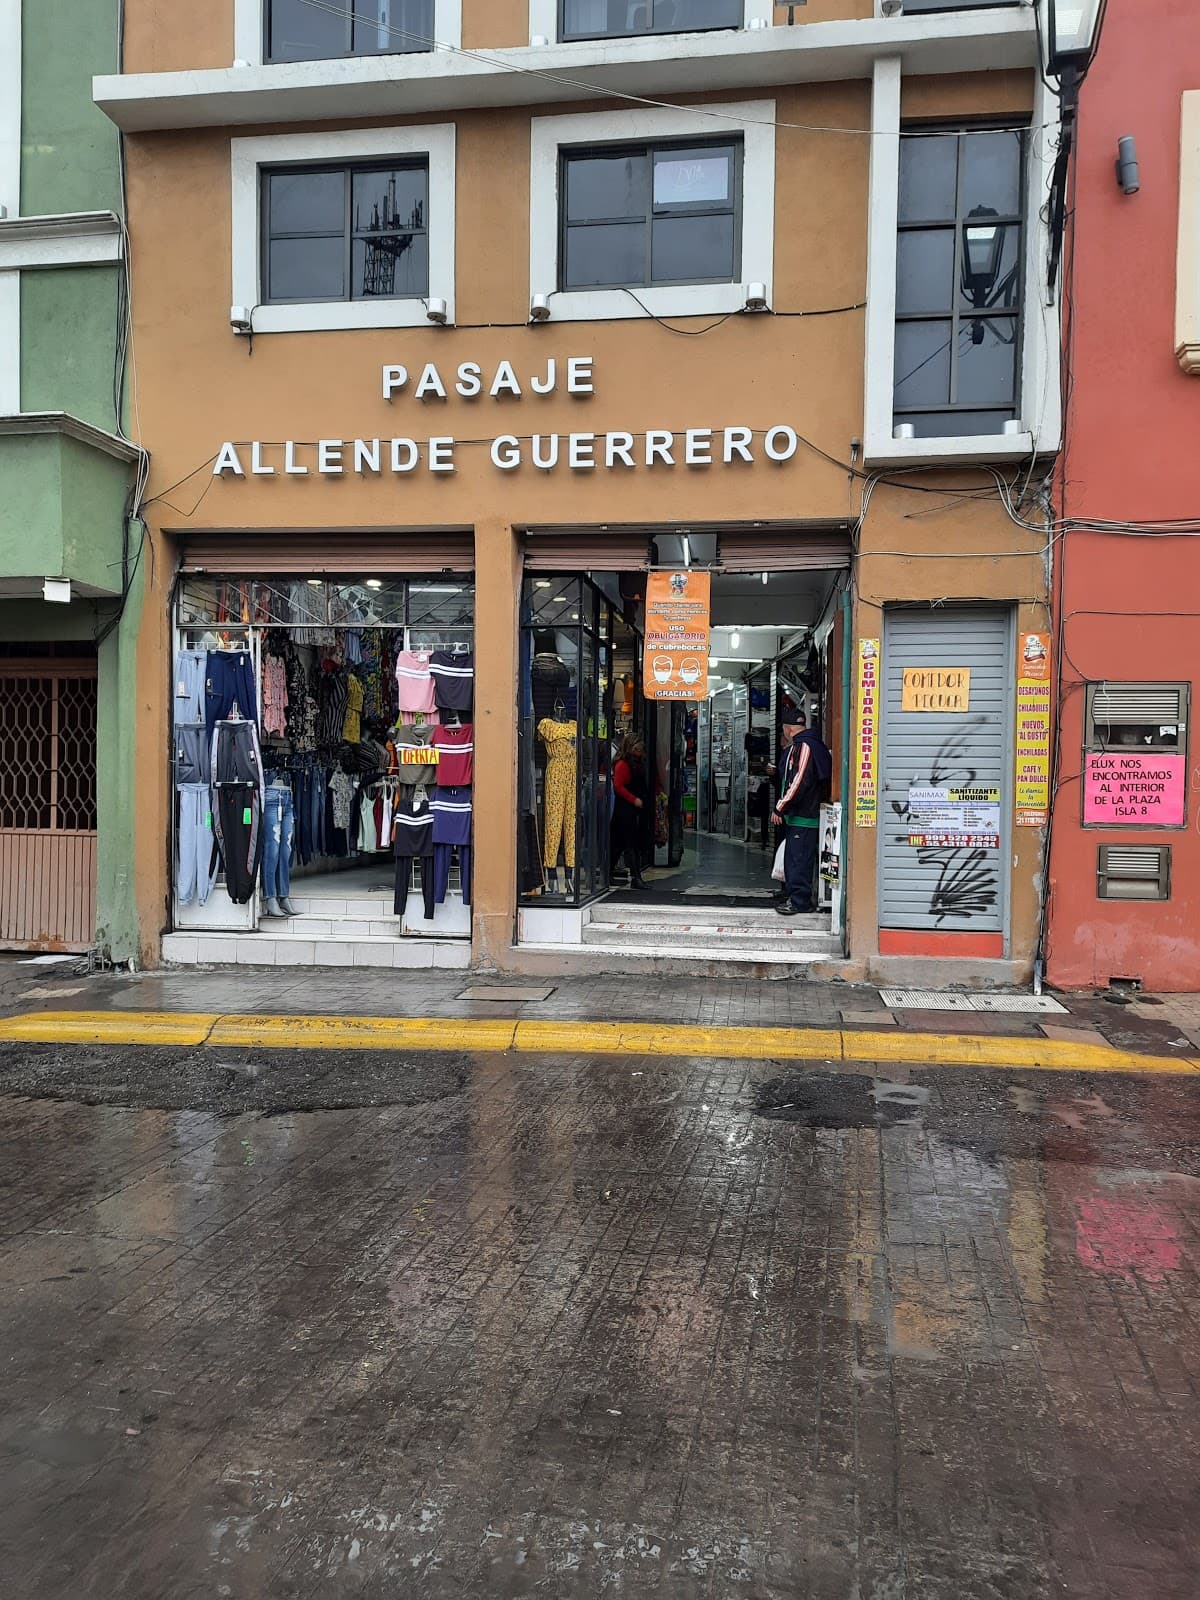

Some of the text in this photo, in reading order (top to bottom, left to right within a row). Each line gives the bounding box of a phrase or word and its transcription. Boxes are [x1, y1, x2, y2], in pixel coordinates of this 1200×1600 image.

[382, 357, 594, 399] PASAJE
[212, 425, 798, 476] ALLENDE GUERRERO
[904, 672, 965, 688] COMEDOR
[861, 662, 876, 714] COMIDA
[1018, 687, 1049, 696] DESAYUNOS
[1022, 720, 1044, 729] HUEVOS
[861, 718, 873, 779] CORRIDA
[1091, 760, 1142, 769] ELUX NOS
[1017, 775, 1047, 783] PAN DULCE
[1092, 771, 1172, 781] ENCONTRAMOS
[1100, 783, 1165, 793] AL INTERIOR
[909, 791, 945, 799] SANIMAX
[1094, 795, 1161, 805] DE LA PLAZA
[1115, 806, 1148, 816] ISLA 8
